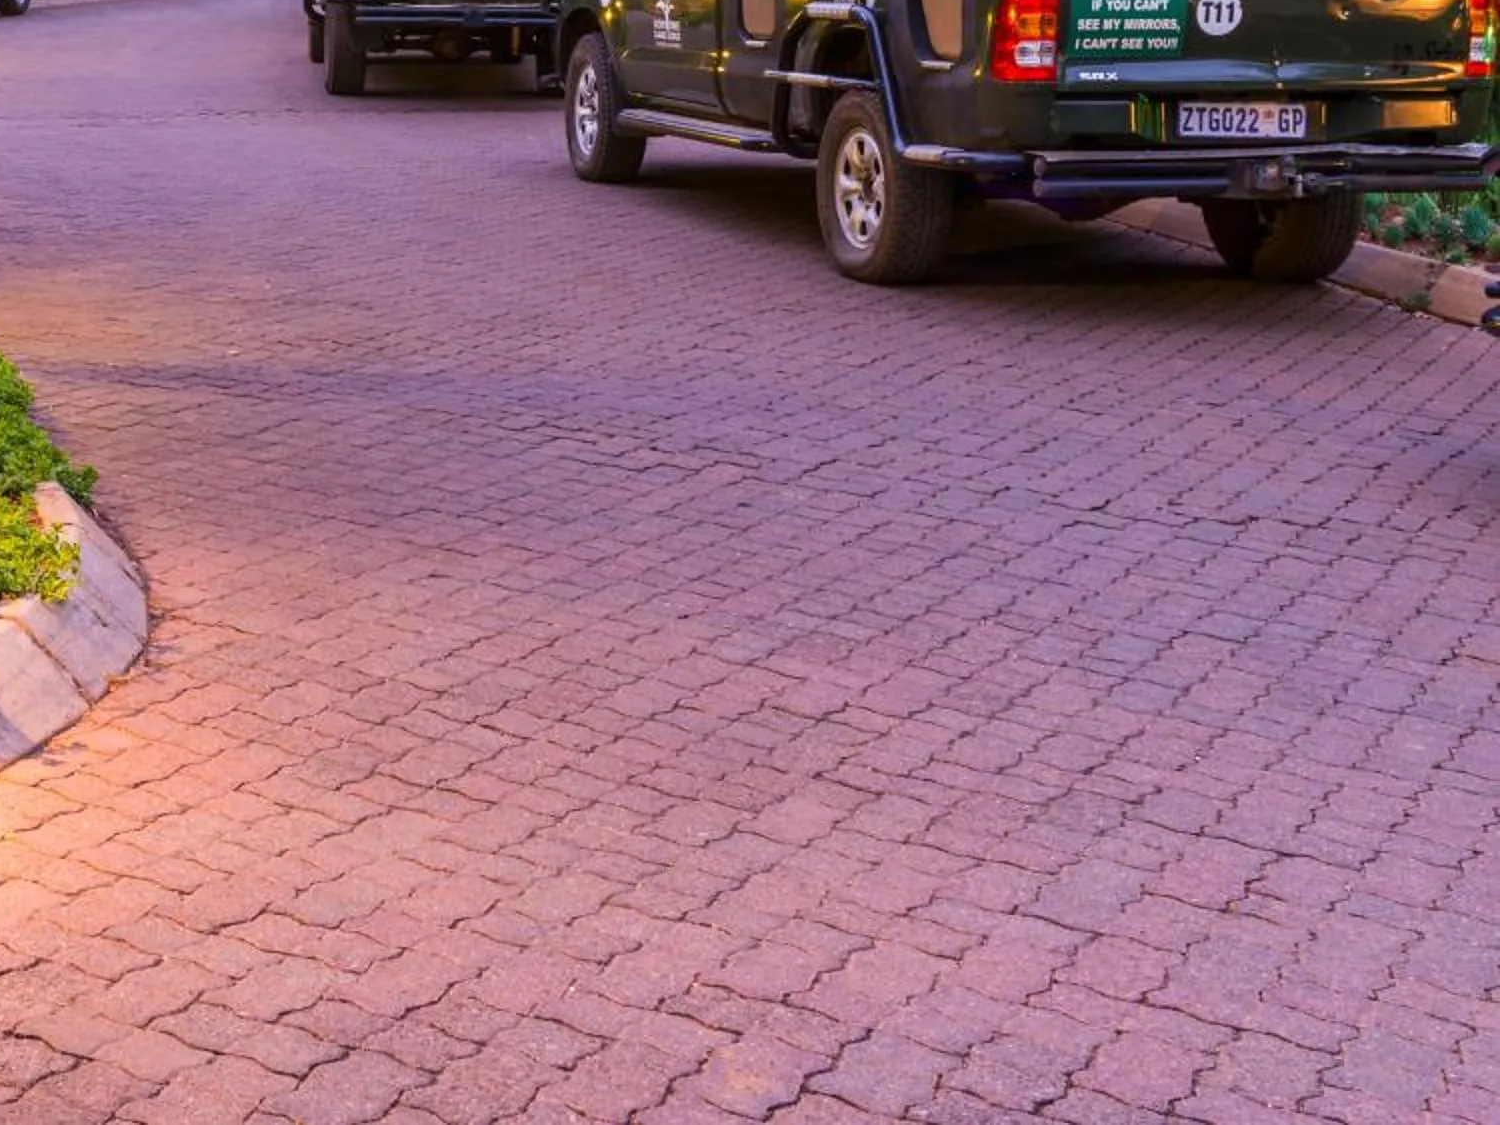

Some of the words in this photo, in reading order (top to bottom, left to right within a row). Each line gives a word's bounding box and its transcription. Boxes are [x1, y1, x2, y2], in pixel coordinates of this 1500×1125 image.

[1202, 1, 1235, 24] T11
[1077, 19, 1100, 31] SEE
[1103, 19, 1121, 31] MY
[1082, 38, 1118, 50] CAN'T
[1121, 38, 1144, 50] SEE
[1278, 108, 1304, 133] GP
